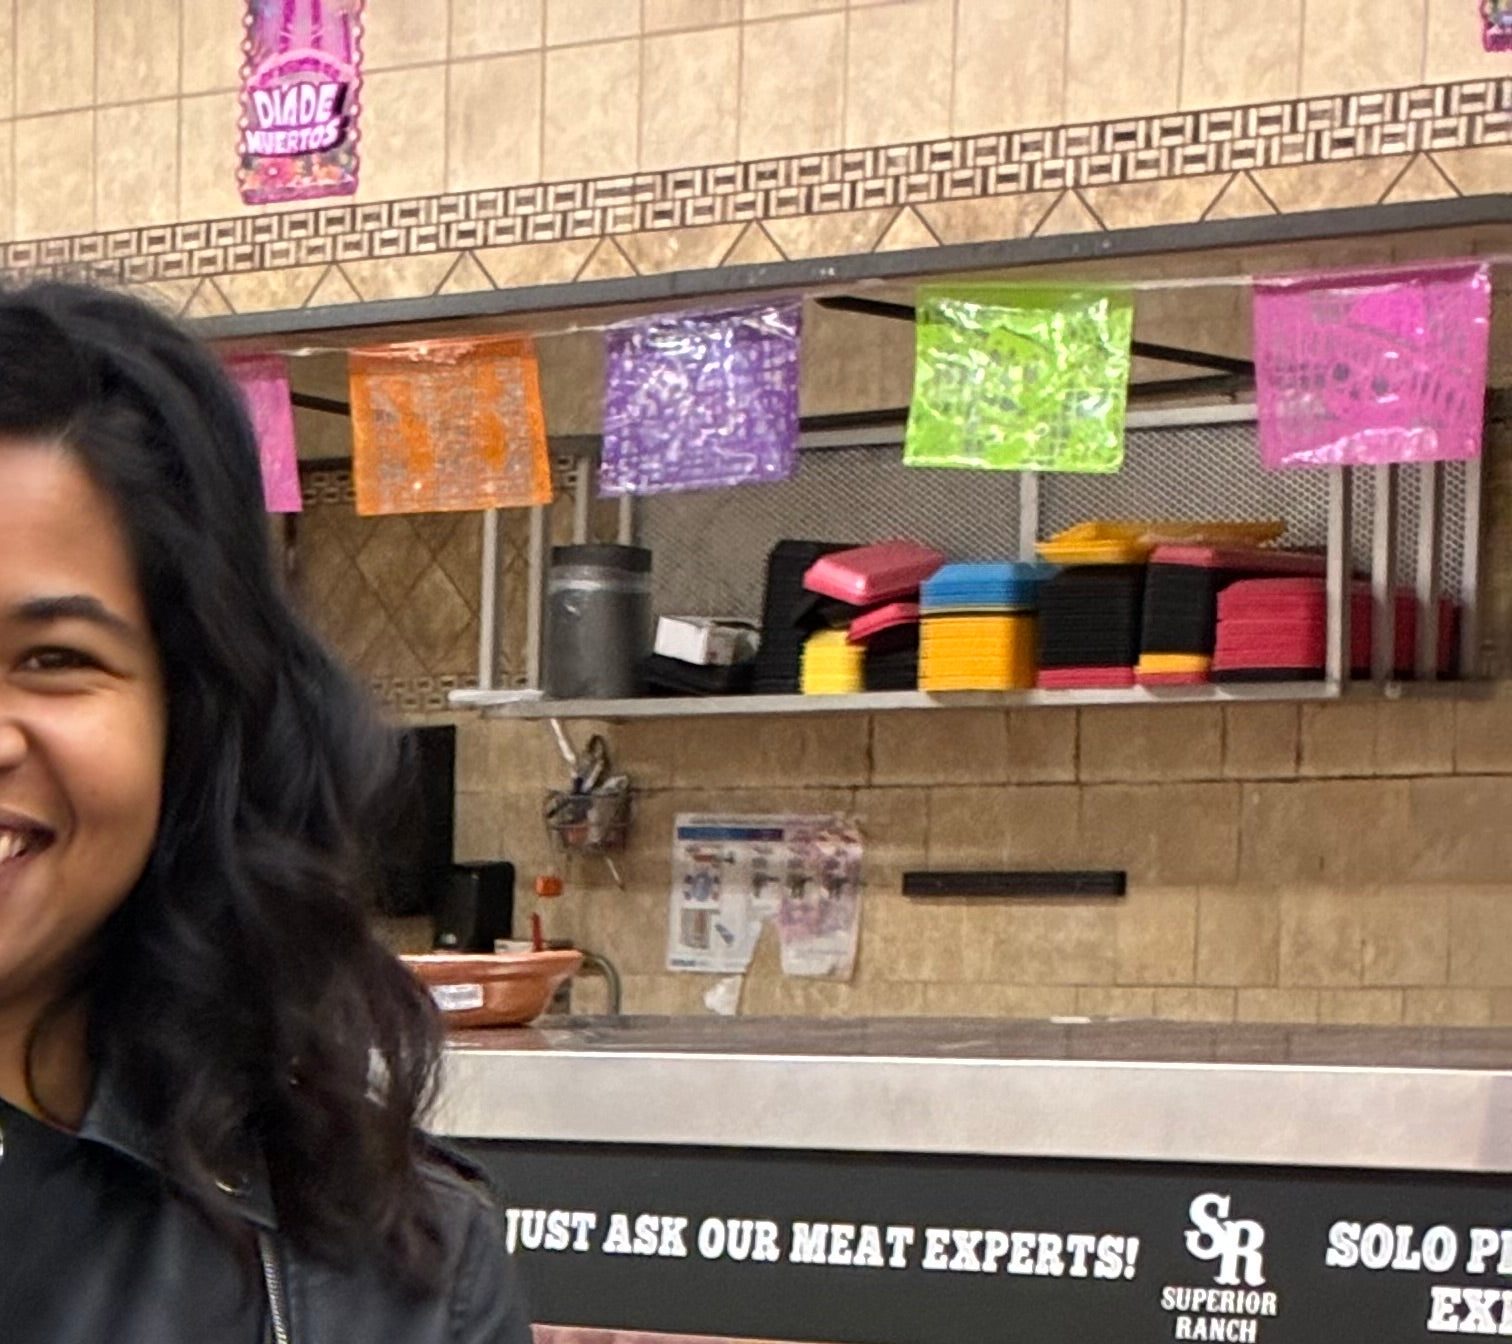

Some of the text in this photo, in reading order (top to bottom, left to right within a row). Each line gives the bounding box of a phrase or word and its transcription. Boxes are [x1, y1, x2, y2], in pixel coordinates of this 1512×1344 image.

[245, 118, 339, 154] MUERTOS
[505, 1208, 1140, 1281] JUST ASK OUR MEAT EXPERTS!
[1325, 1220, 1458, 1273] SOLO
[1160, 1286, 1278, 1316] SUPERIOR
[1175, 1316, 1258, 1344] RANCH
